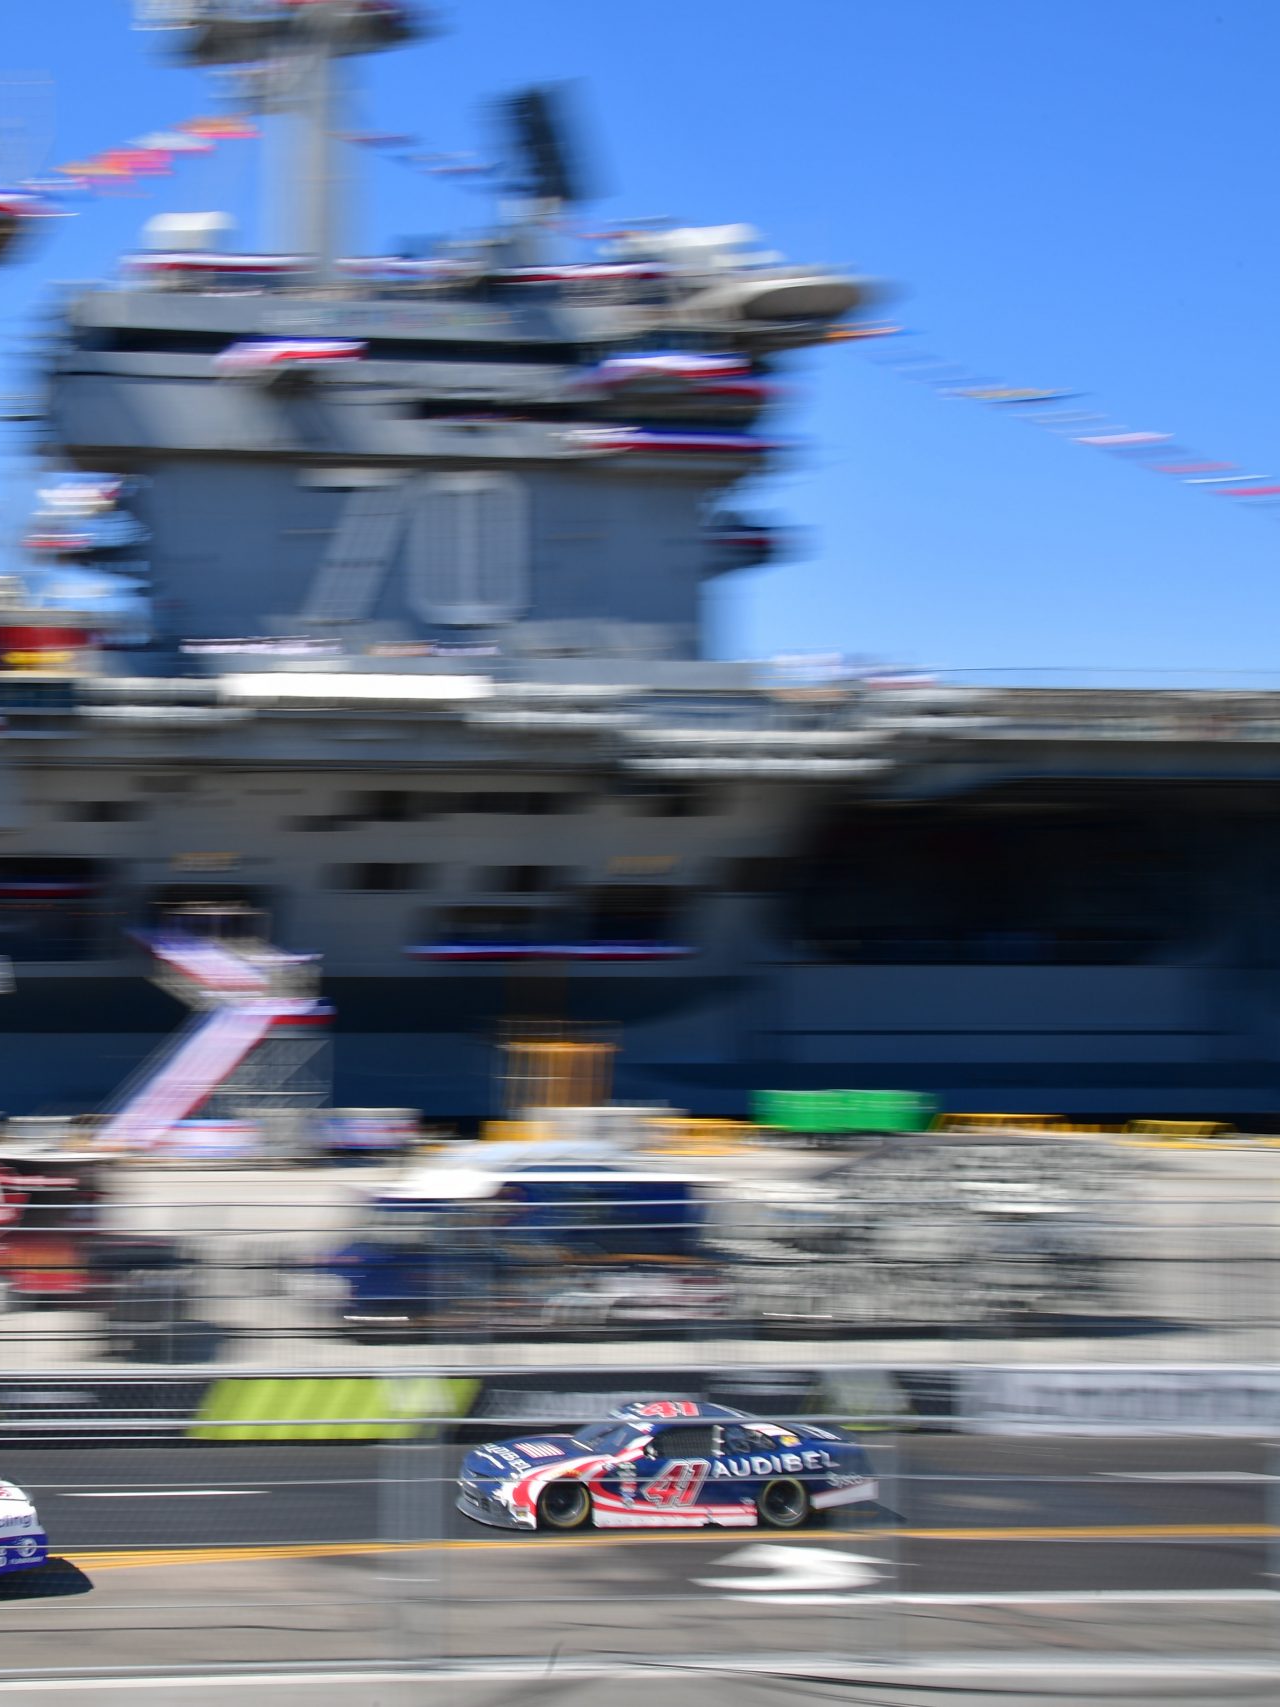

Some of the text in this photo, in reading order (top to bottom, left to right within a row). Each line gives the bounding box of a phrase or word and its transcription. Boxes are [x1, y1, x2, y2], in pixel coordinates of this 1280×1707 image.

[294, 466, 531, 623] 70
[639, 1401, 699, 1417] 41
[640, 1458, 712, 1508] 41
[712, 1449, 840, 1478] AUDIBEL
